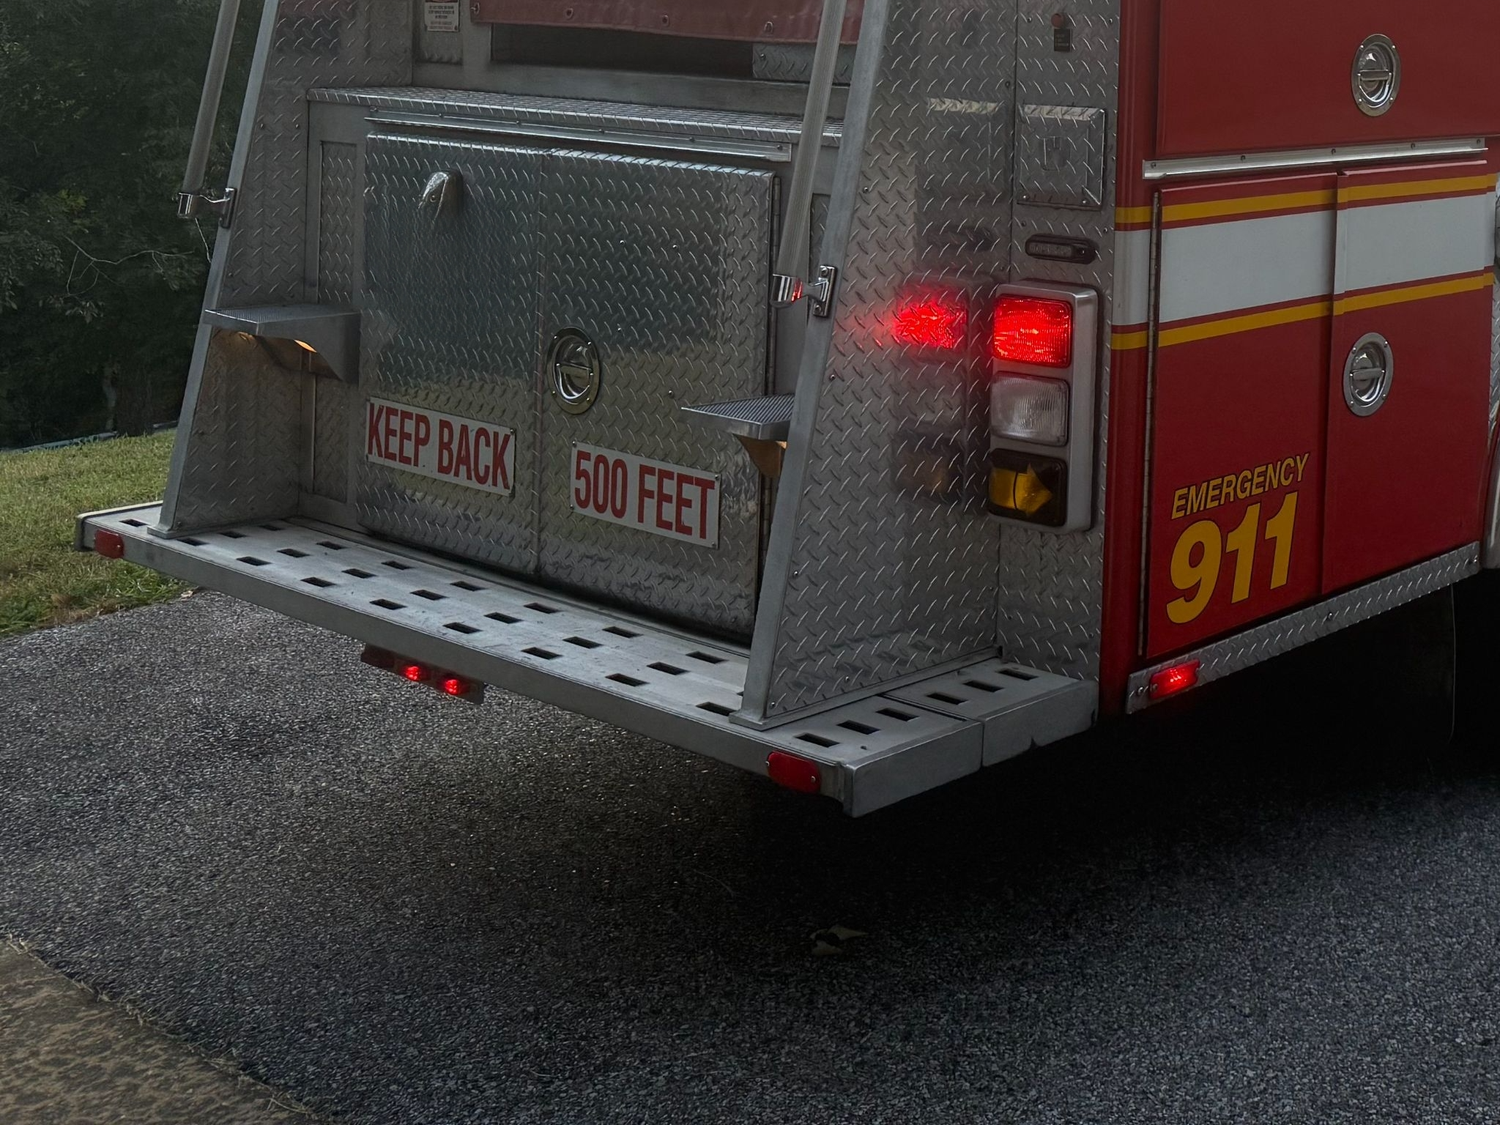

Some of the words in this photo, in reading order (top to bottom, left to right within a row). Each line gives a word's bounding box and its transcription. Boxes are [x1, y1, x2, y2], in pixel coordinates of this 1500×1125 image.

[367, 402, 430, 468] KEEP
[437, 420, 510, 490] BACK
[1171, 452, 1309, 520] EMERGENCY
[574, 450, 628, 519] 500
[637, 464, 715, 540] FEET
[1166, 491, 1298, 624] 911
